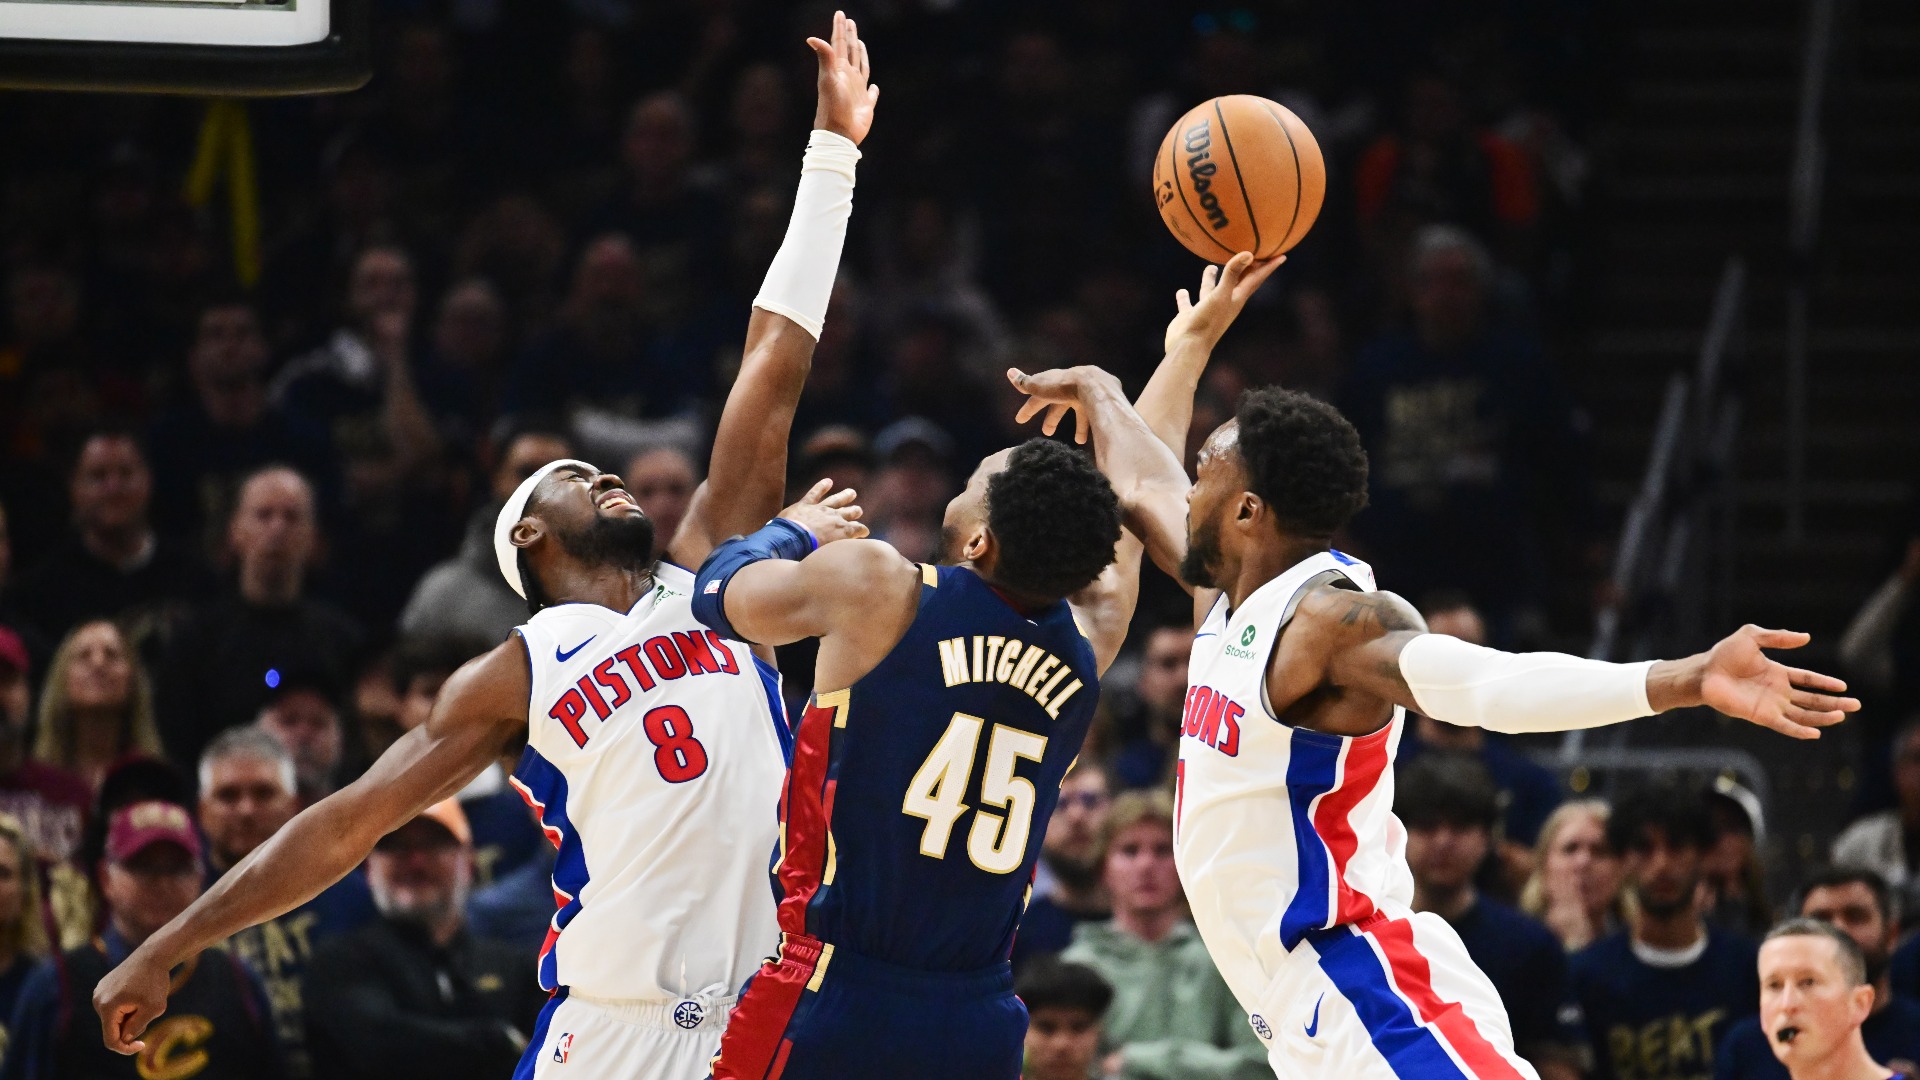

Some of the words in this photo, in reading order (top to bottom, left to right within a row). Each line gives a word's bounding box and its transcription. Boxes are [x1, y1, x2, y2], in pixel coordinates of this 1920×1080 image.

[1184, 118, 1230, 232] Wilson
[548, 629, 740, 749] PISTONS
[938, 634, 1084, 720] MITCHELL
[643, 704, 709, 784] 8
[902, 711, 1049, 875] 45
